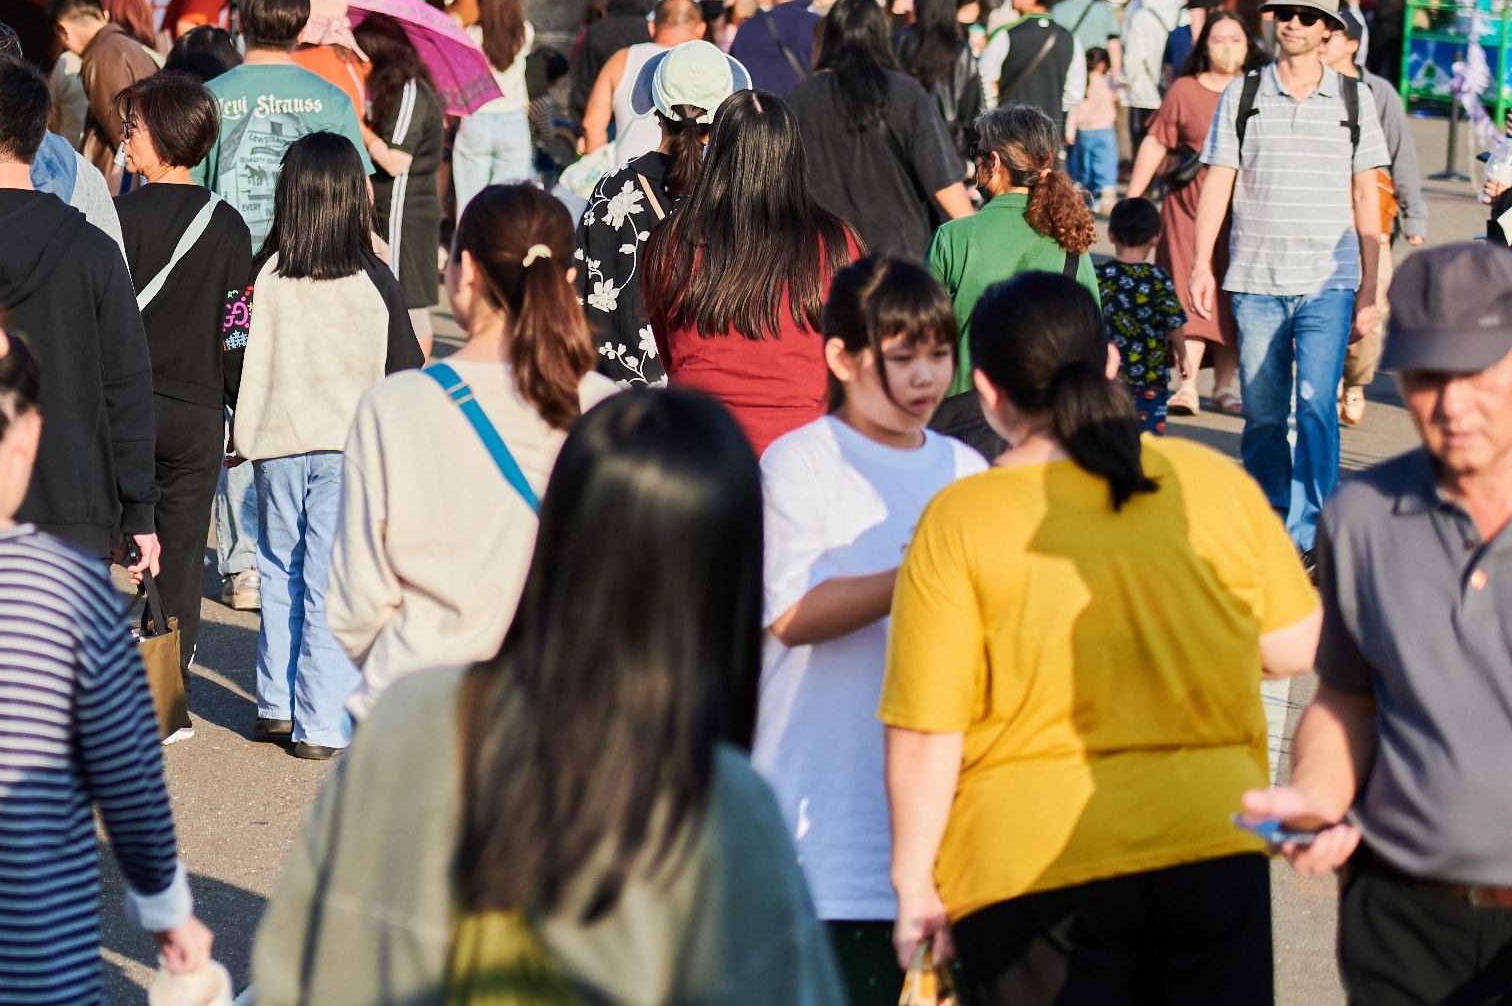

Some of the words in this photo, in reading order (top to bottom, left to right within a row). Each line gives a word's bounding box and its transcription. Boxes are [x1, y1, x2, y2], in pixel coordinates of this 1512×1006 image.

[254, 94, 323, 119] Strauss
[248, 134, 264, 144] LEVI
[239, 156, 265, 164] QUALITY
[241, 203, 261, 212] EVERY
